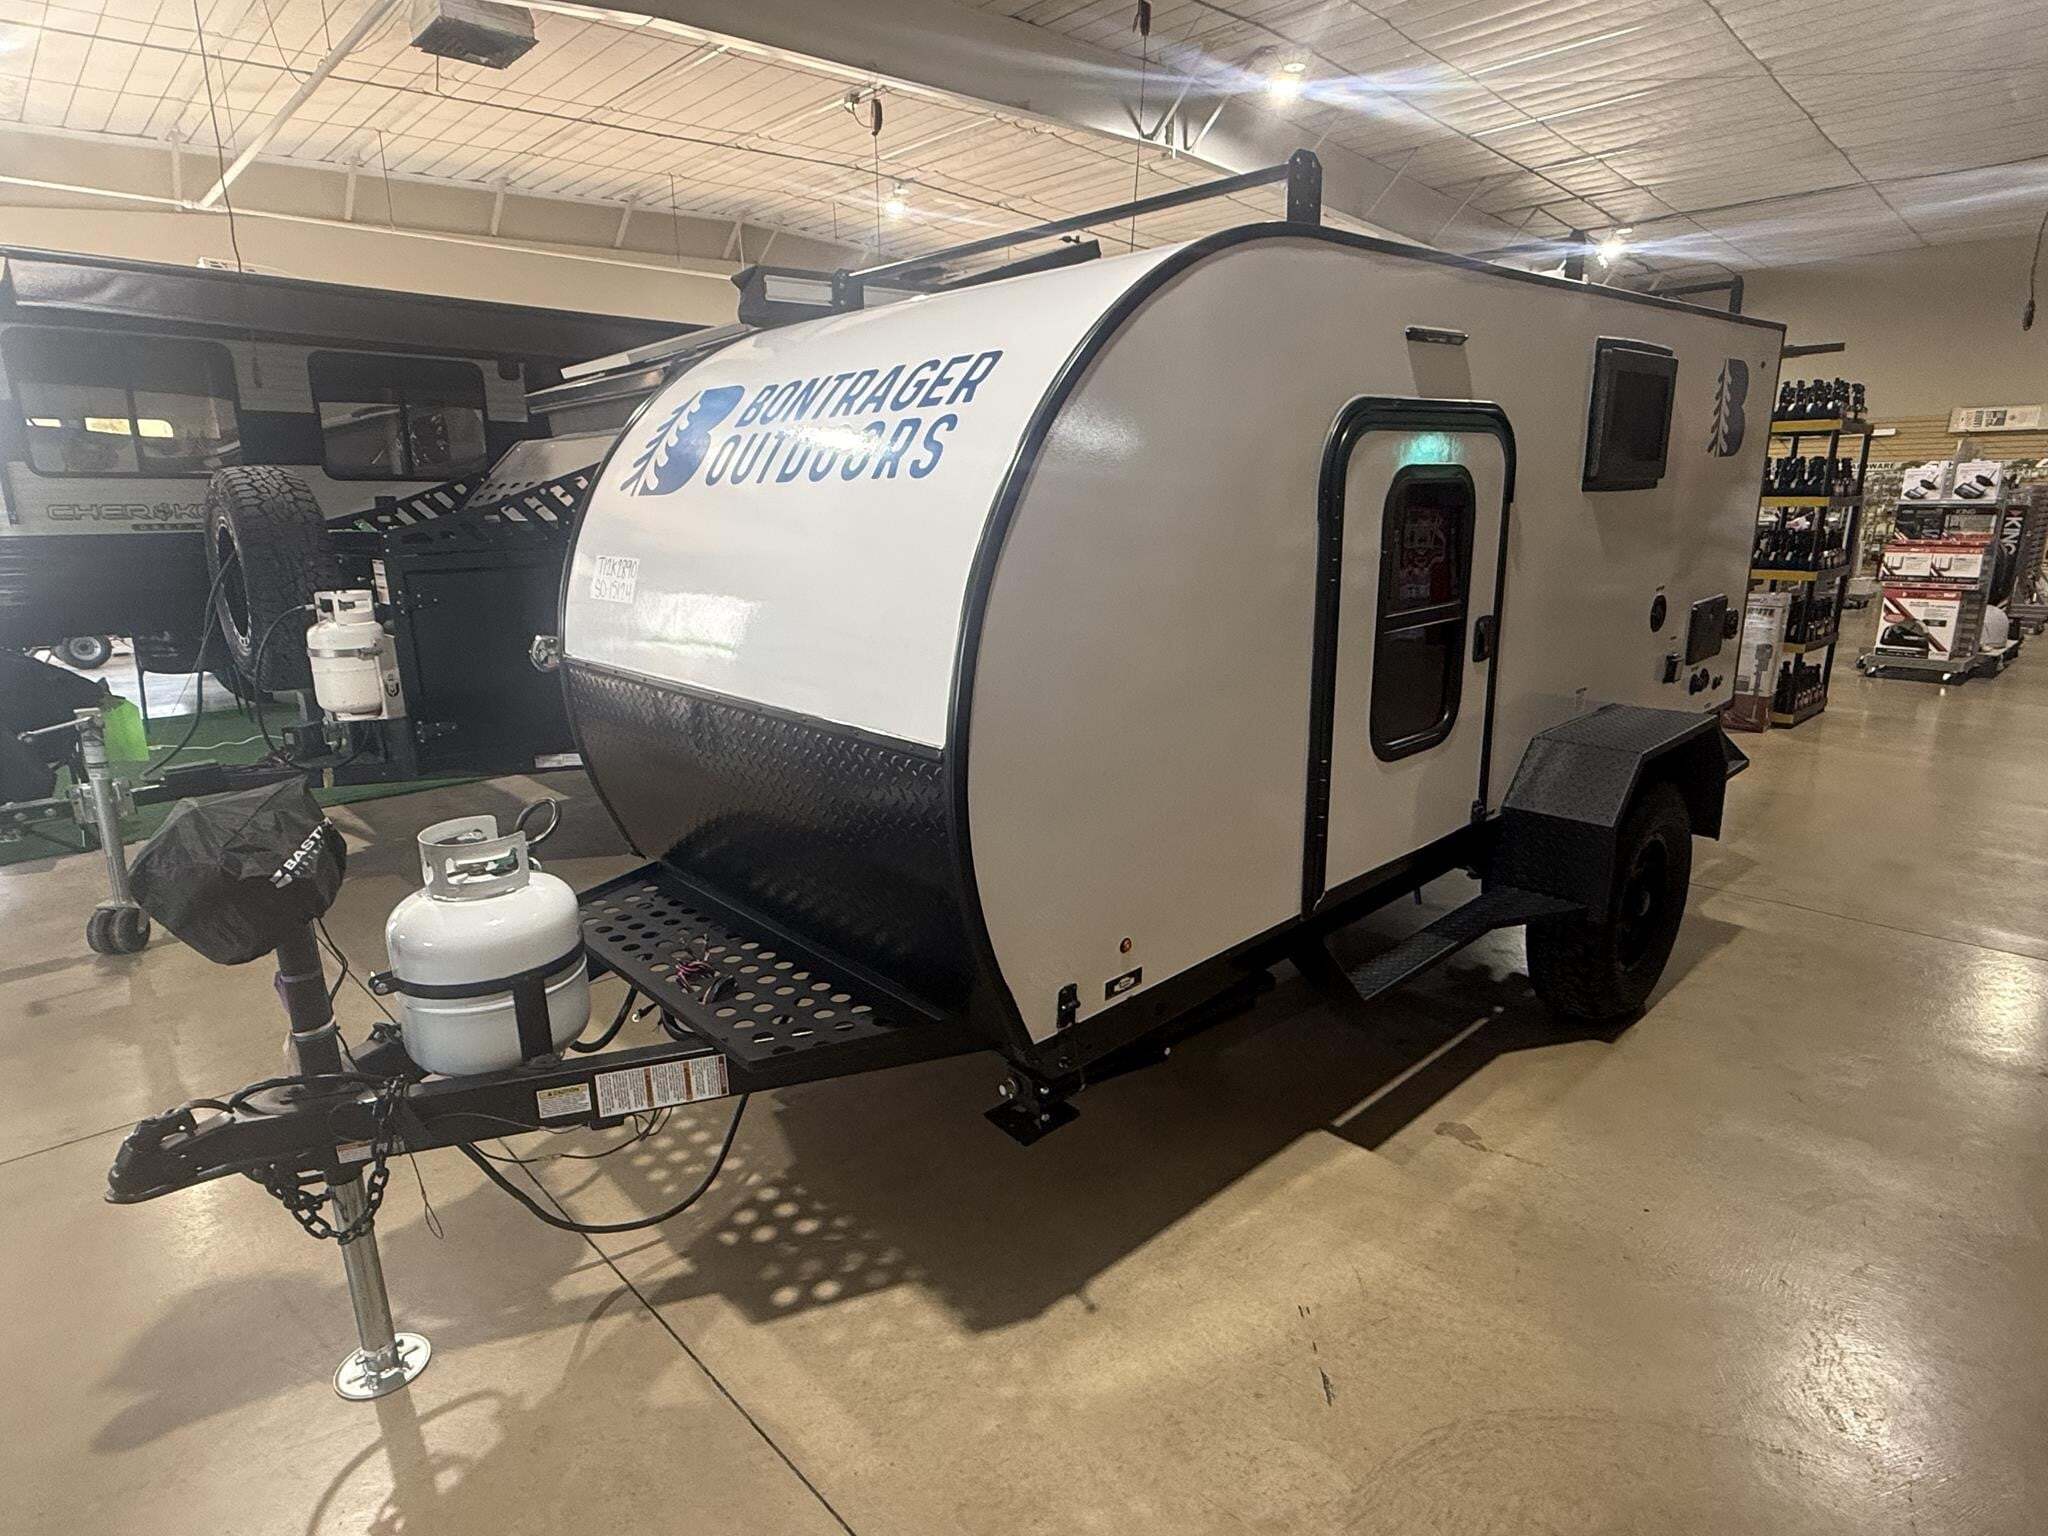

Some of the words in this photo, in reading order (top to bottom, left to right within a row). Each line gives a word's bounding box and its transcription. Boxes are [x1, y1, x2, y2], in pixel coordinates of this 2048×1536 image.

[735, 350, 1003, 427] BONTRAGER
[705, 414, 958, 486] OUTDOORS
[283, 817, 332, 870] BASTI
